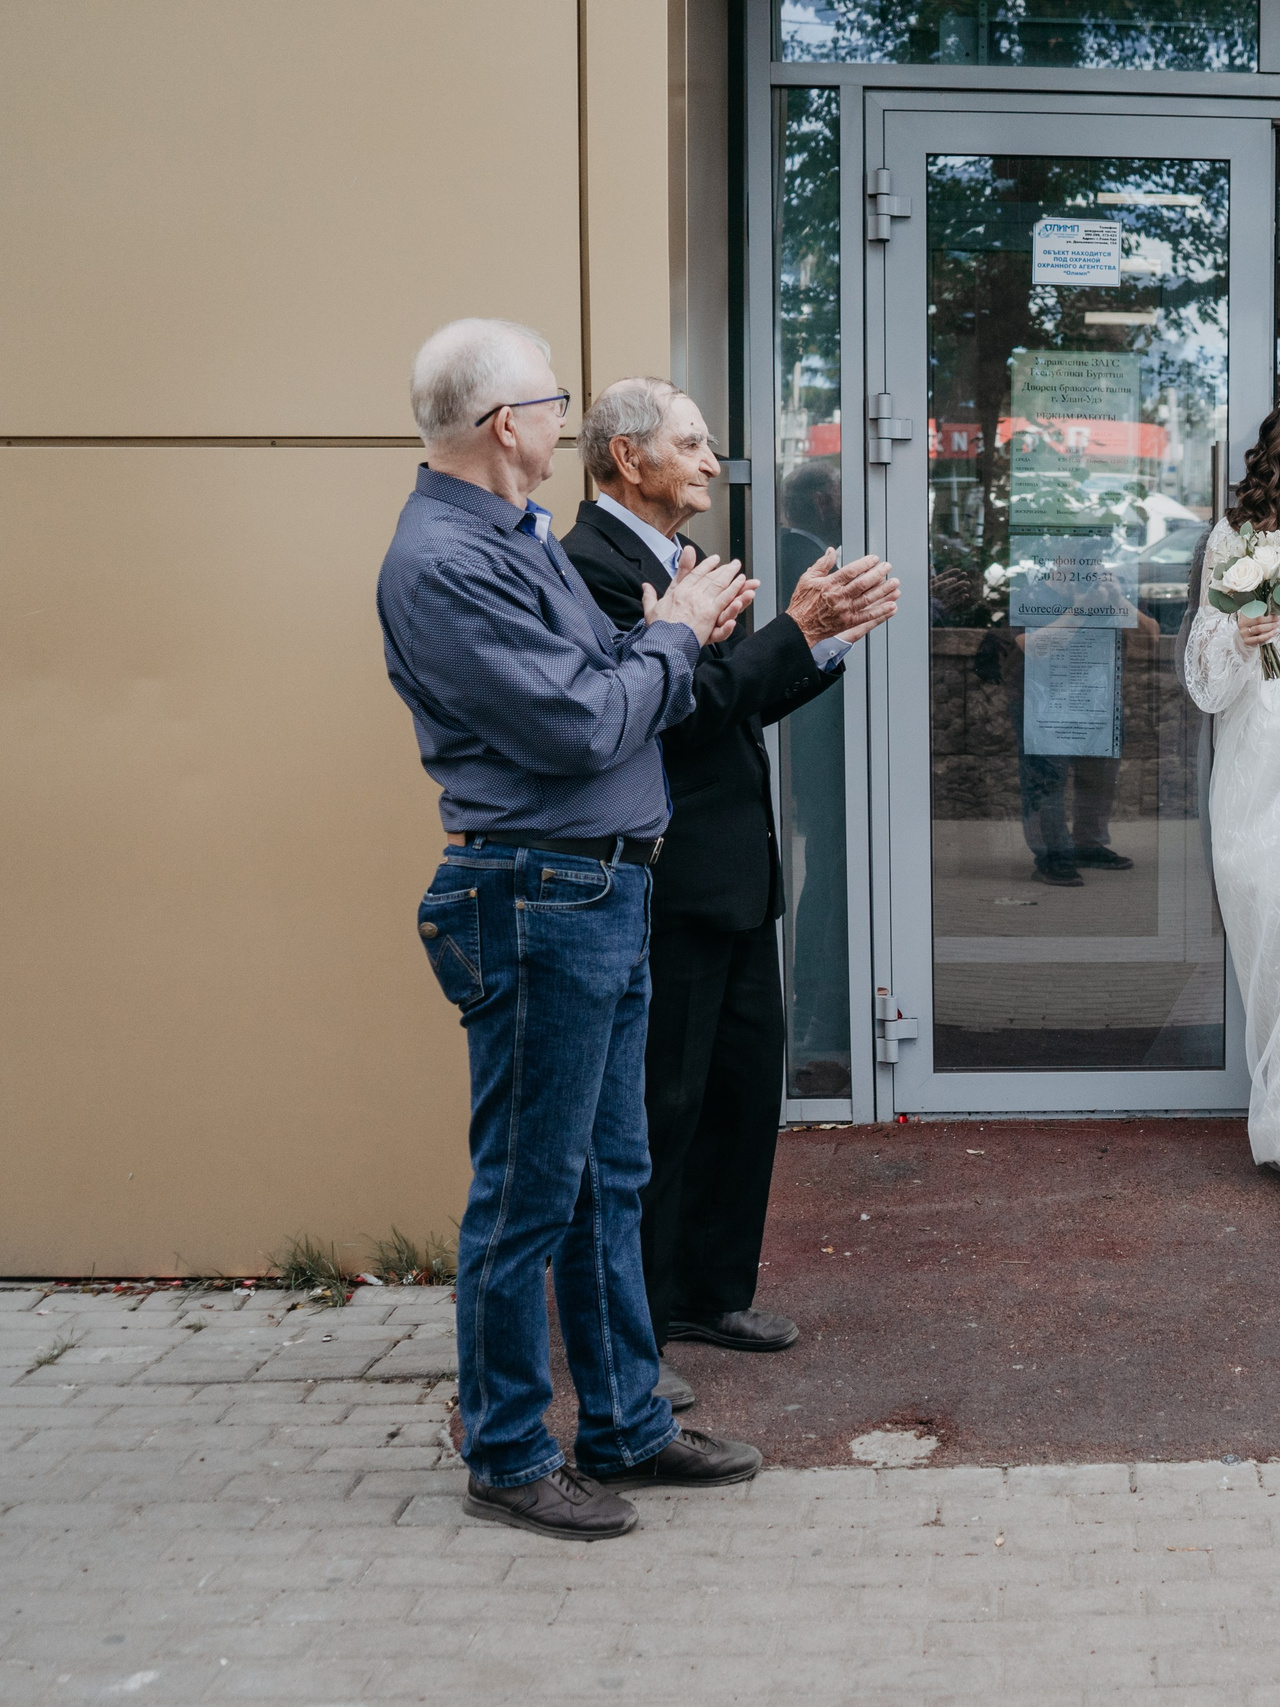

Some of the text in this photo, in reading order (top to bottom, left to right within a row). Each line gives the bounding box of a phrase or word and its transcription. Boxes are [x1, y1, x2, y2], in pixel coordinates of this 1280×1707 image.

[1044, 224, 1079, 232] ОЛИМП
[1091, 358, 1120, 368] ЗАГС
[1086, 369, 1124, 379] Бурятия
[1021, 382, 1132, 394] Дворец бракосочетания
[1061, 394, 1103, 404] Улан-Удэ
[1036, 412, 1117, 421] РЕЖИМ РАБОТЫ
[1069, 572, 1113, 582] 21-65-31
[1018, 604, 1129, 617] dvorec@zags.govrb.ru
